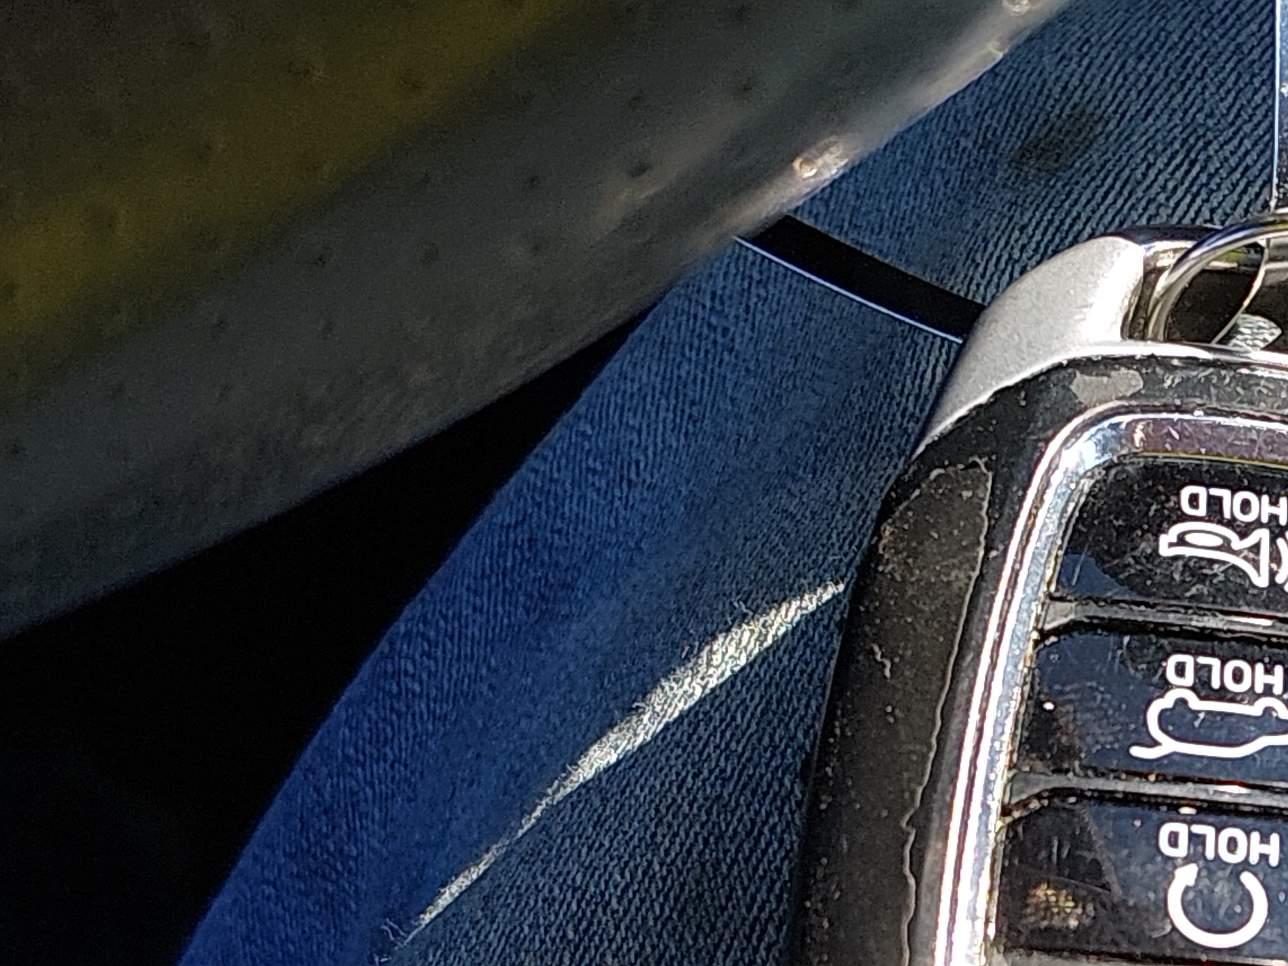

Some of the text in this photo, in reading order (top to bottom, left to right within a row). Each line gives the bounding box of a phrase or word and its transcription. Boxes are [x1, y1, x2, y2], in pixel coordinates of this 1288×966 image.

[1180, 485, 1288, 526] HOLD
[1166, 653, 1284, 696] HOLD
[1158, 822, 1280, 868] HOLD
